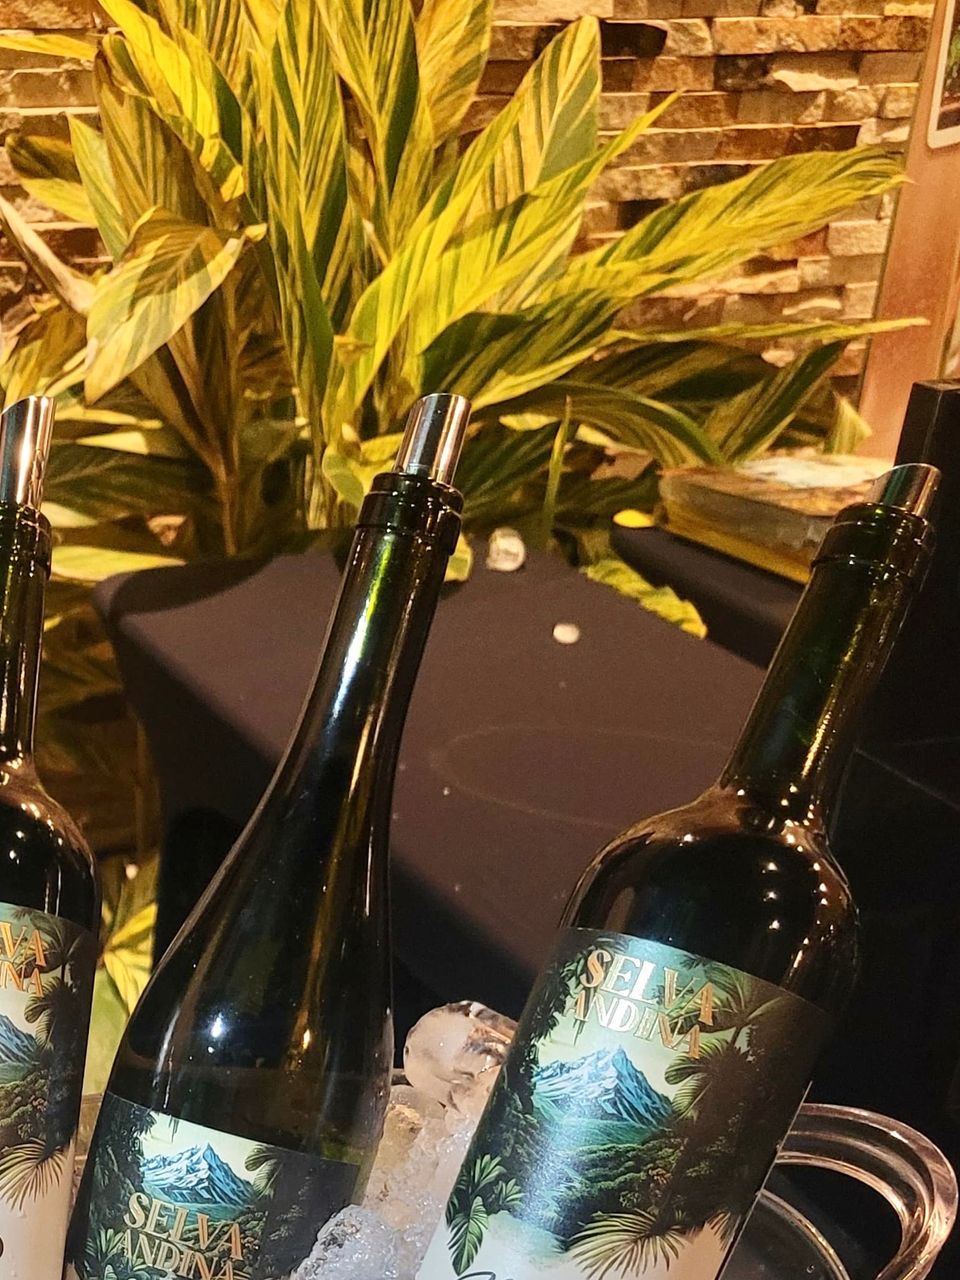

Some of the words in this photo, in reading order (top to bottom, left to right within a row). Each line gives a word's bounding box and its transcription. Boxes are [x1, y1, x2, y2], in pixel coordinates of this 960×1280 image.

[579, 949, 714, 1026] SELVA
[570, 989, 701, 1059] ANDINA
[123, 1192, 243, 1260] SELVA
